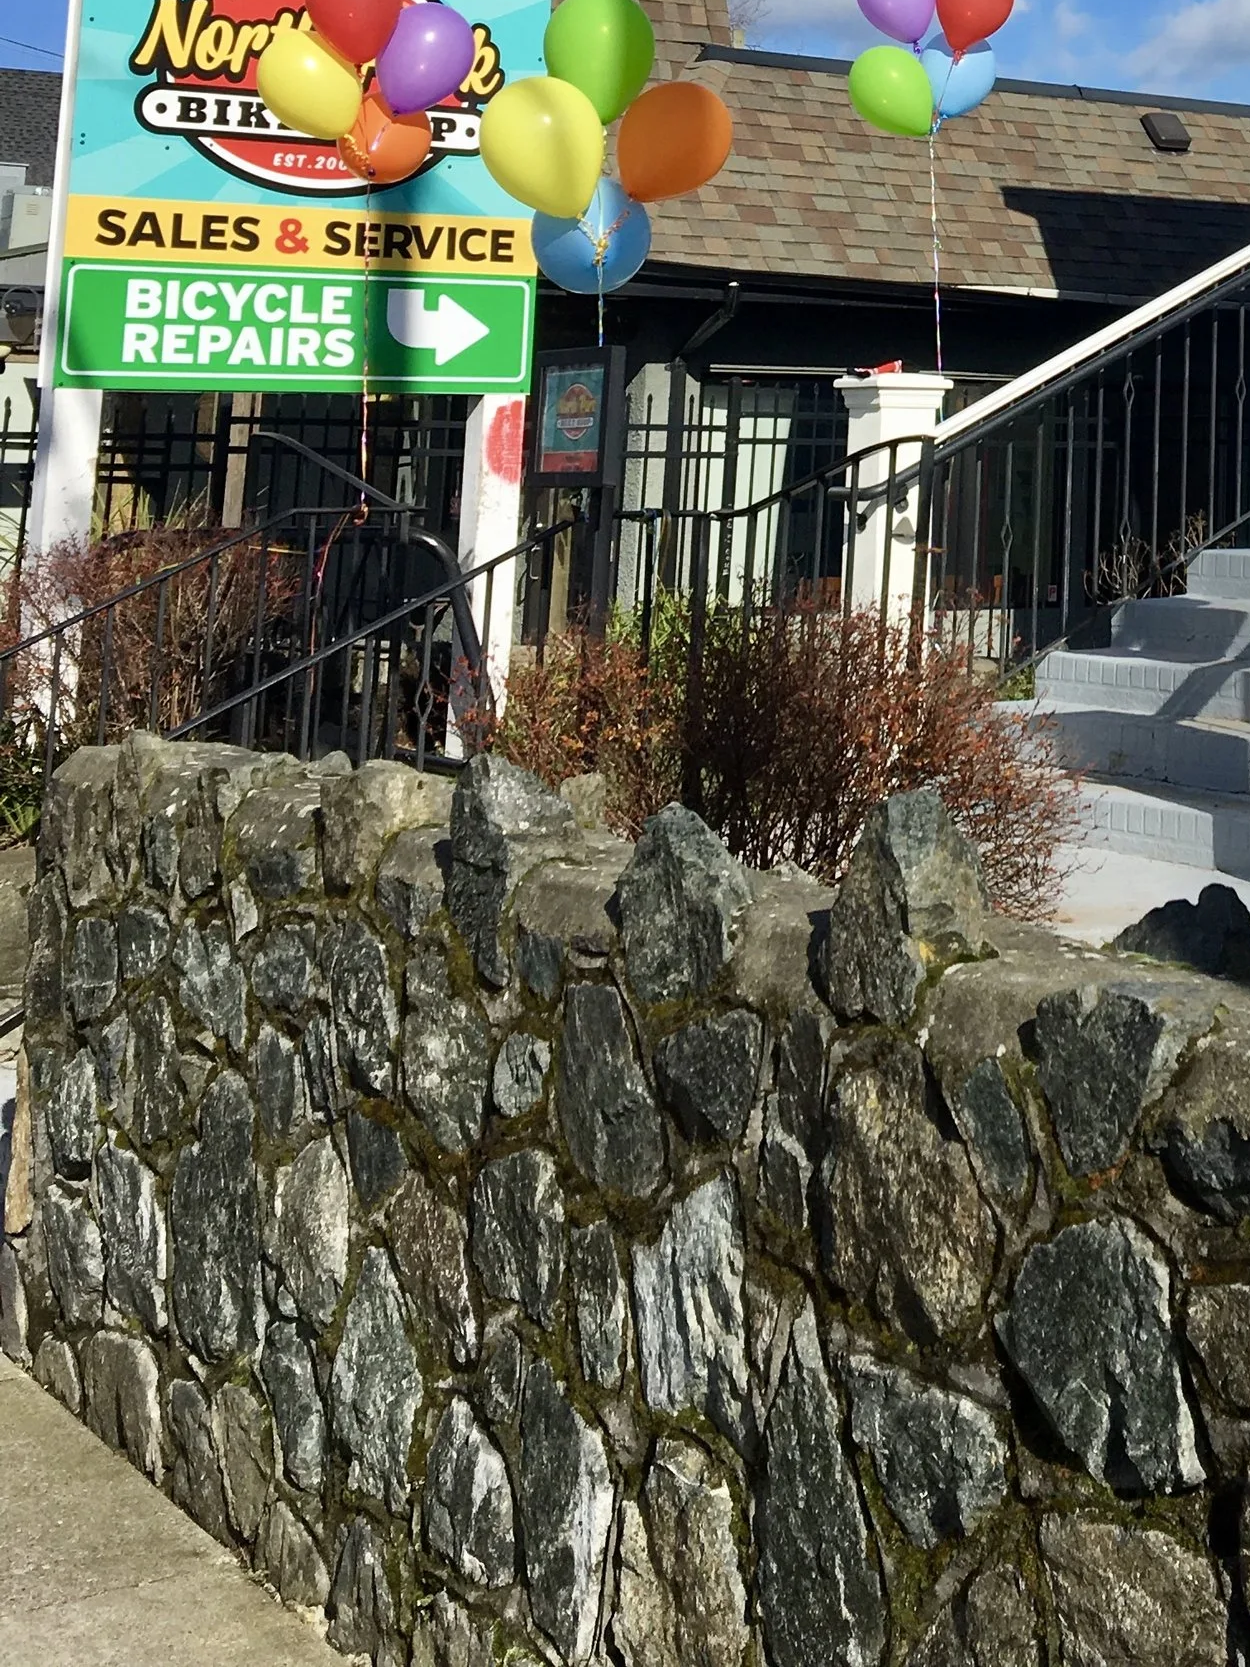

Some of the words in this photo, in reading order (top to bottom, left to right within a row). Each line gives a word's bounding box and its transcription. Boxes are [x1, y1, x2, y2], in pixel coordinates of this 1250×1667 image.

[176, 96, 292, 131] BIK
[96, 209, 260, 252] SALES
[274, 218, 310, 254] &
[323, 220, 515, 263] SERVICE
[126, 278, 353, 324] BICYCLE
[121, 324, 355, 367] REPAIRS
